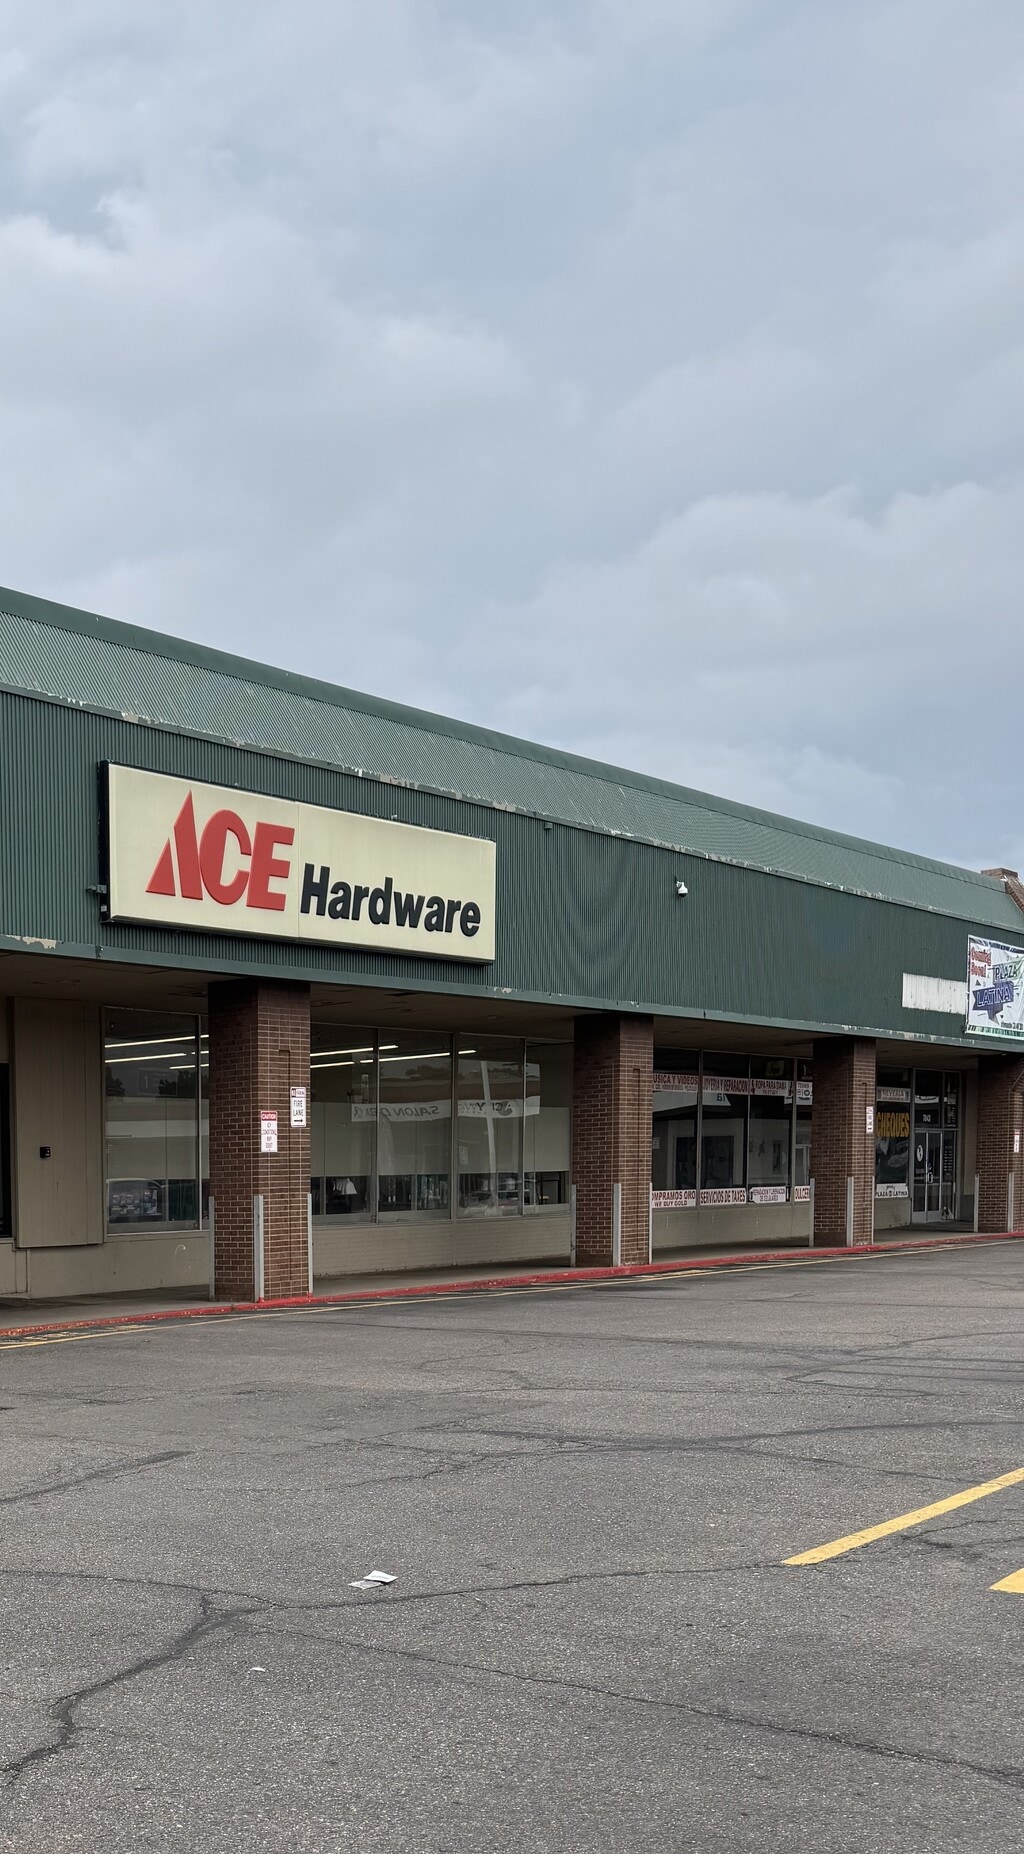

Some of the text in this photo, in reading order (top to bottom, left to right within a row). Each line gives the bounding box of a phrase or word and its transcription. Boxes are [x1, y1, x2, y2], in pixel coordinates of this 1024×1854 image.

[145, 789, 481, 937] ACE Hardware
[995, 964, 1018, 980] PLAZA
[976, 986, 1011, 1007] LATINA
[653, 1074, 671, 1084] USICA
[677, 1076, 698, 1085] VIDEOS
[293, 1109, 304, 1117] LANE
[876, 1112, 910, 1138] CHEQUES
[684, 1190, 696, 1200] ORO
[701, 1190, 724, 1204] SERVICIOS
[725, 1190, 731, 1203] DE
[731, 1189, 746, 1202] TAXES
